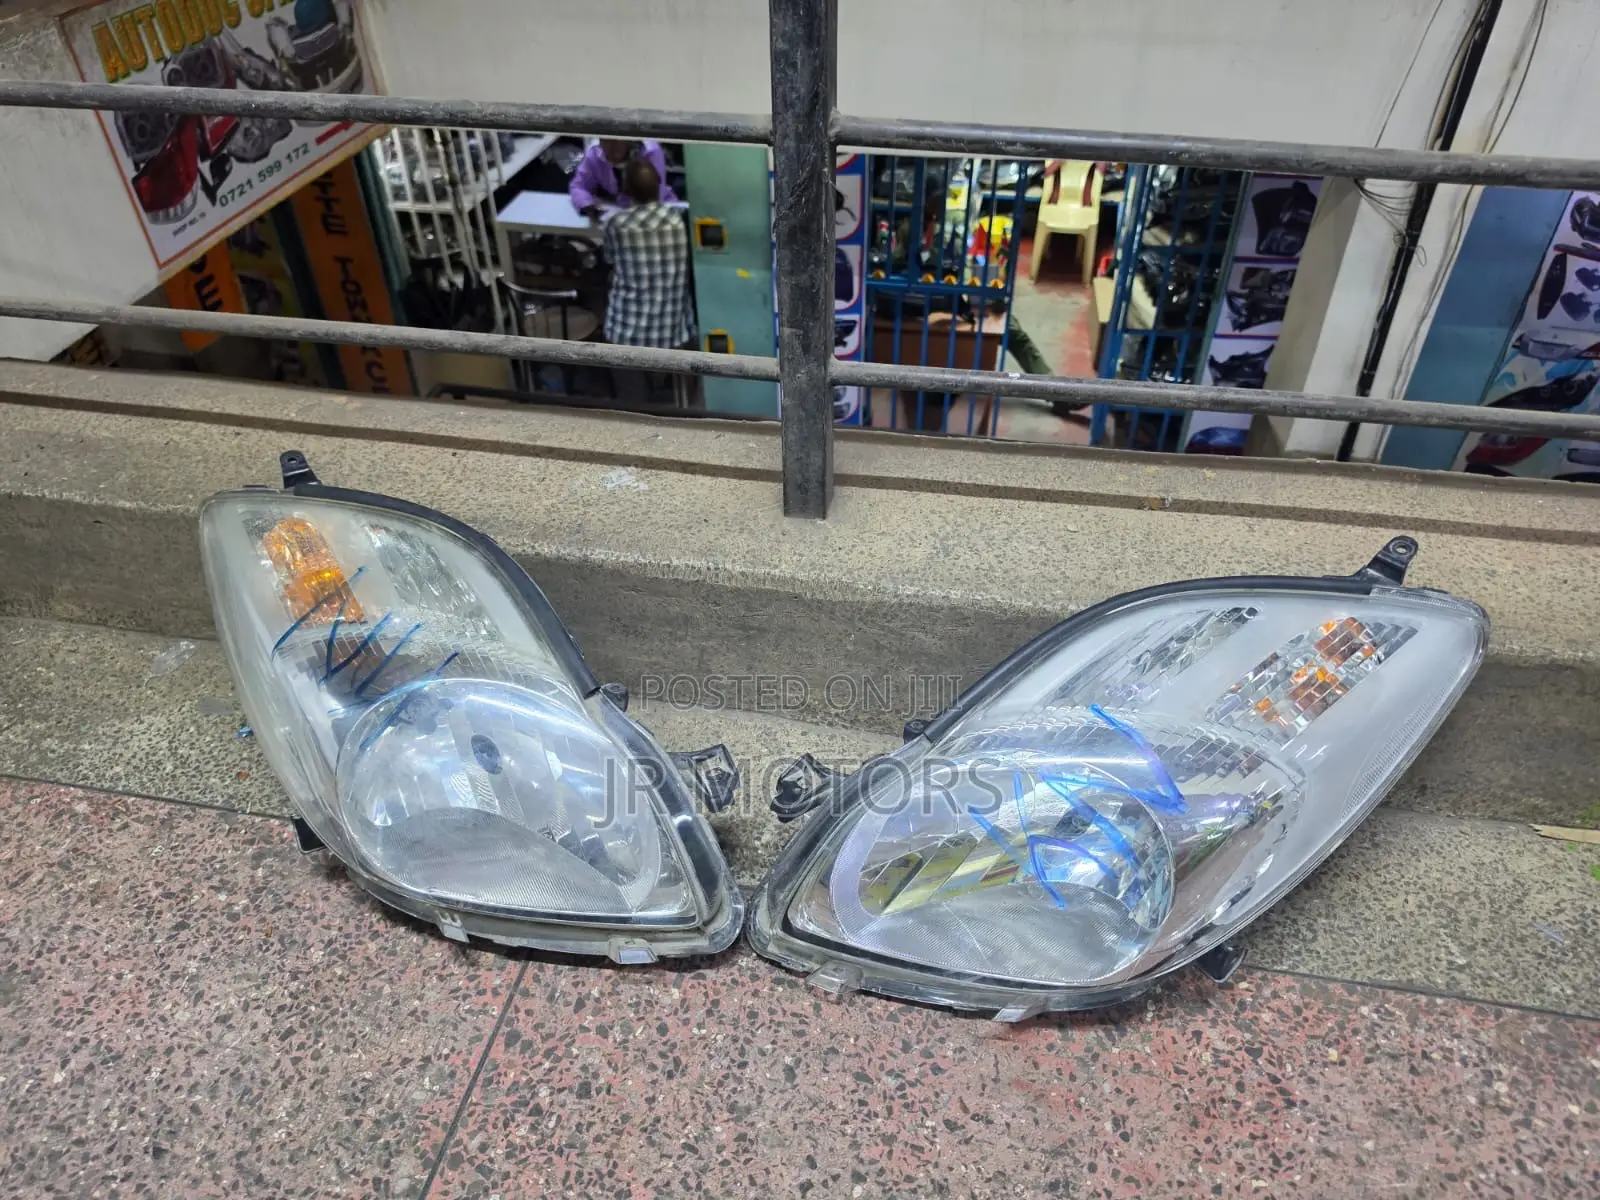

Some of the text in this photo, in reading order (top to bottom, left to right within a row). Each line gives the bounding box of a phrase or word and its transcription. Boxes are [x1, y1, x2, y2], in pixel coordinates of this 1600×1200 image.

[218, 142, 310, 207] 0721 599 172
